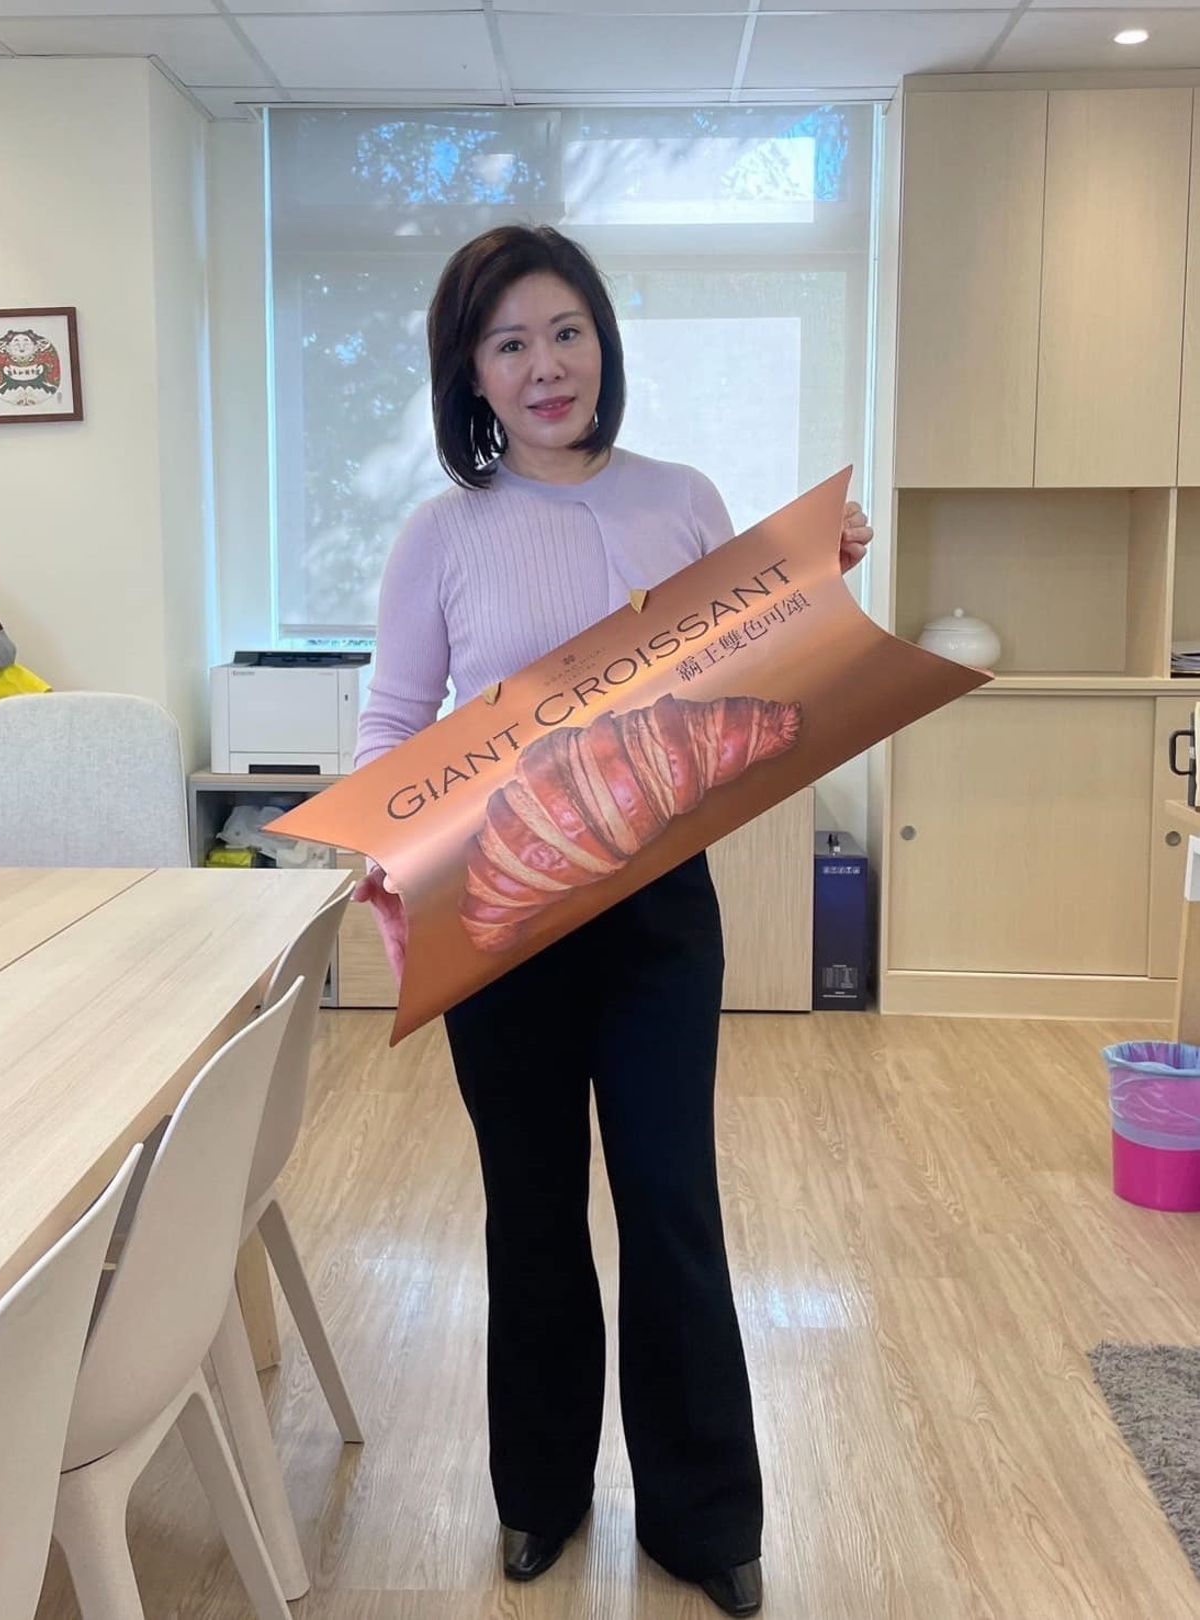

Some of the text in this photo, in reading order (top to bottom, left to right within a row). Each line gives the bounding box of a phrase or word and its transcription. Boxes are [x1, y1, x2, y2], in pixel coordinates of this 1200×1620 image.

[386, 558, 792, 822] GIANT CROISSANT
[675, 589, 811, 682] 霸王雙色可頌
